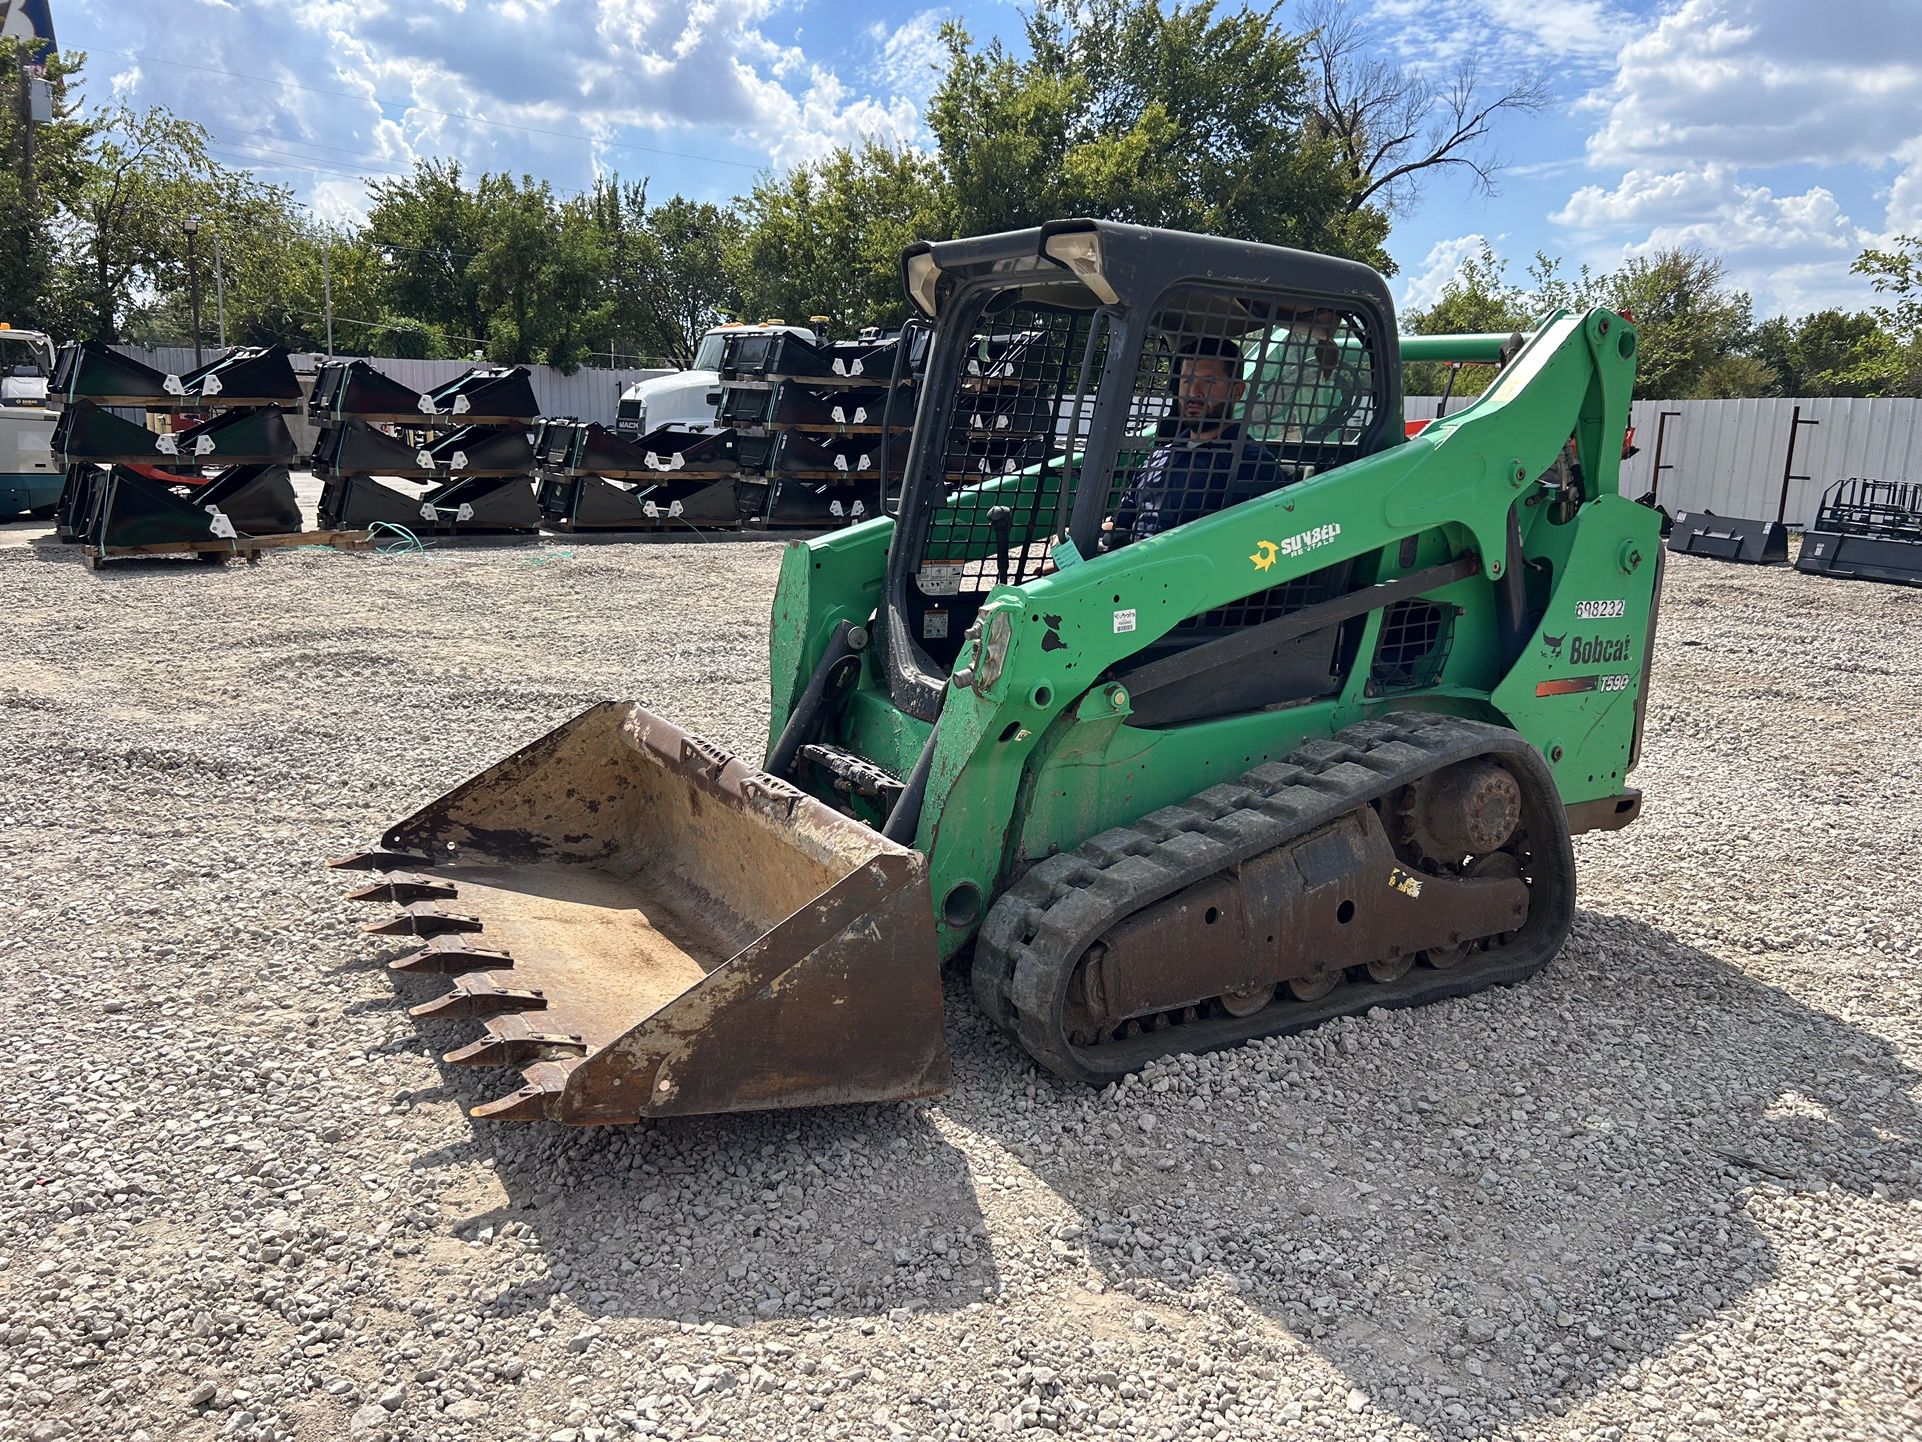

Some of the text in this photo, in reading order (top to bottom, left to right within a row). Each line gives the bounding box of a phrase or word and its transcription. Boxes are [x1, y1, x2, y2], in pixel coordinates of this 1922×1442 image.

[619, 421, 639, 429] MACK
[1576, 601, 1624, 618] 698232
[1570, 634, 1631, 665] Bobcat
